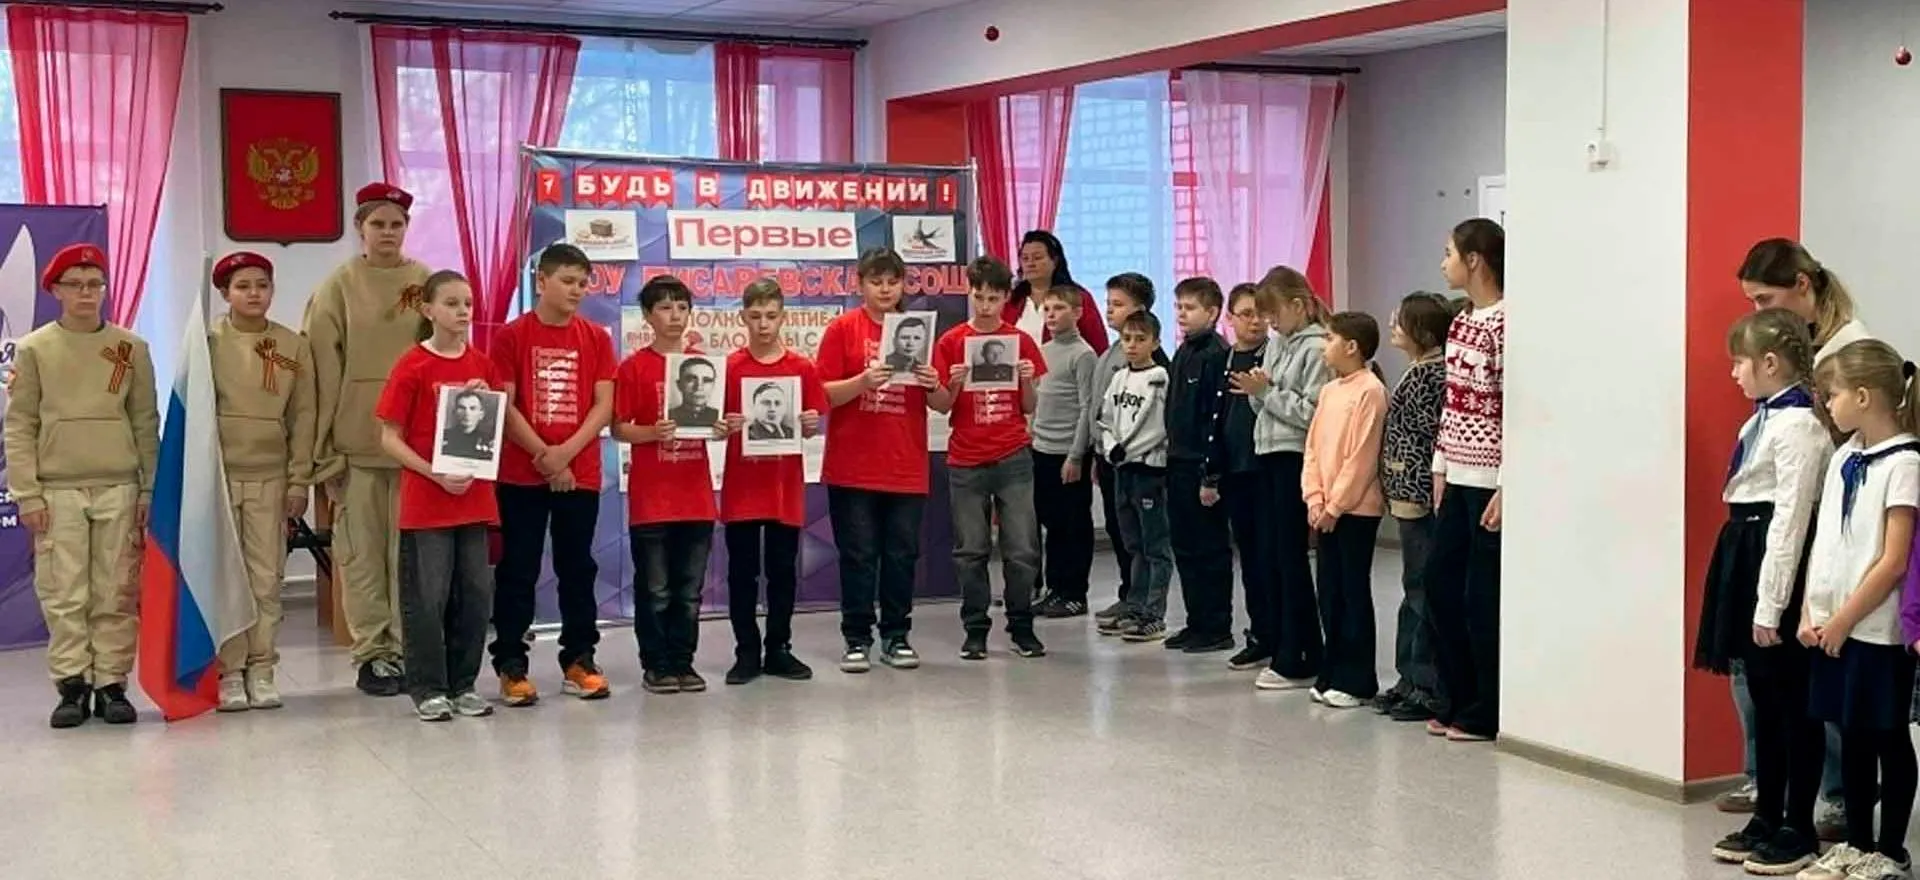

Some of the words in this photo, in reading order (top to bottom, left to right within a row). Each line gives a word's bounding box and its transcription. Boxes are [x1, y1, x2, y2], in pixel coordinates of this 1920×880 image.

[577, 174, 672, 199] БУДЬ
[699, 177, 717, 195] В
[748, 179, 928, 201] ДВИЖЕНИИ
[674, 218, 853, 255] Первые
[903, 265, 969, 295] СОШ
